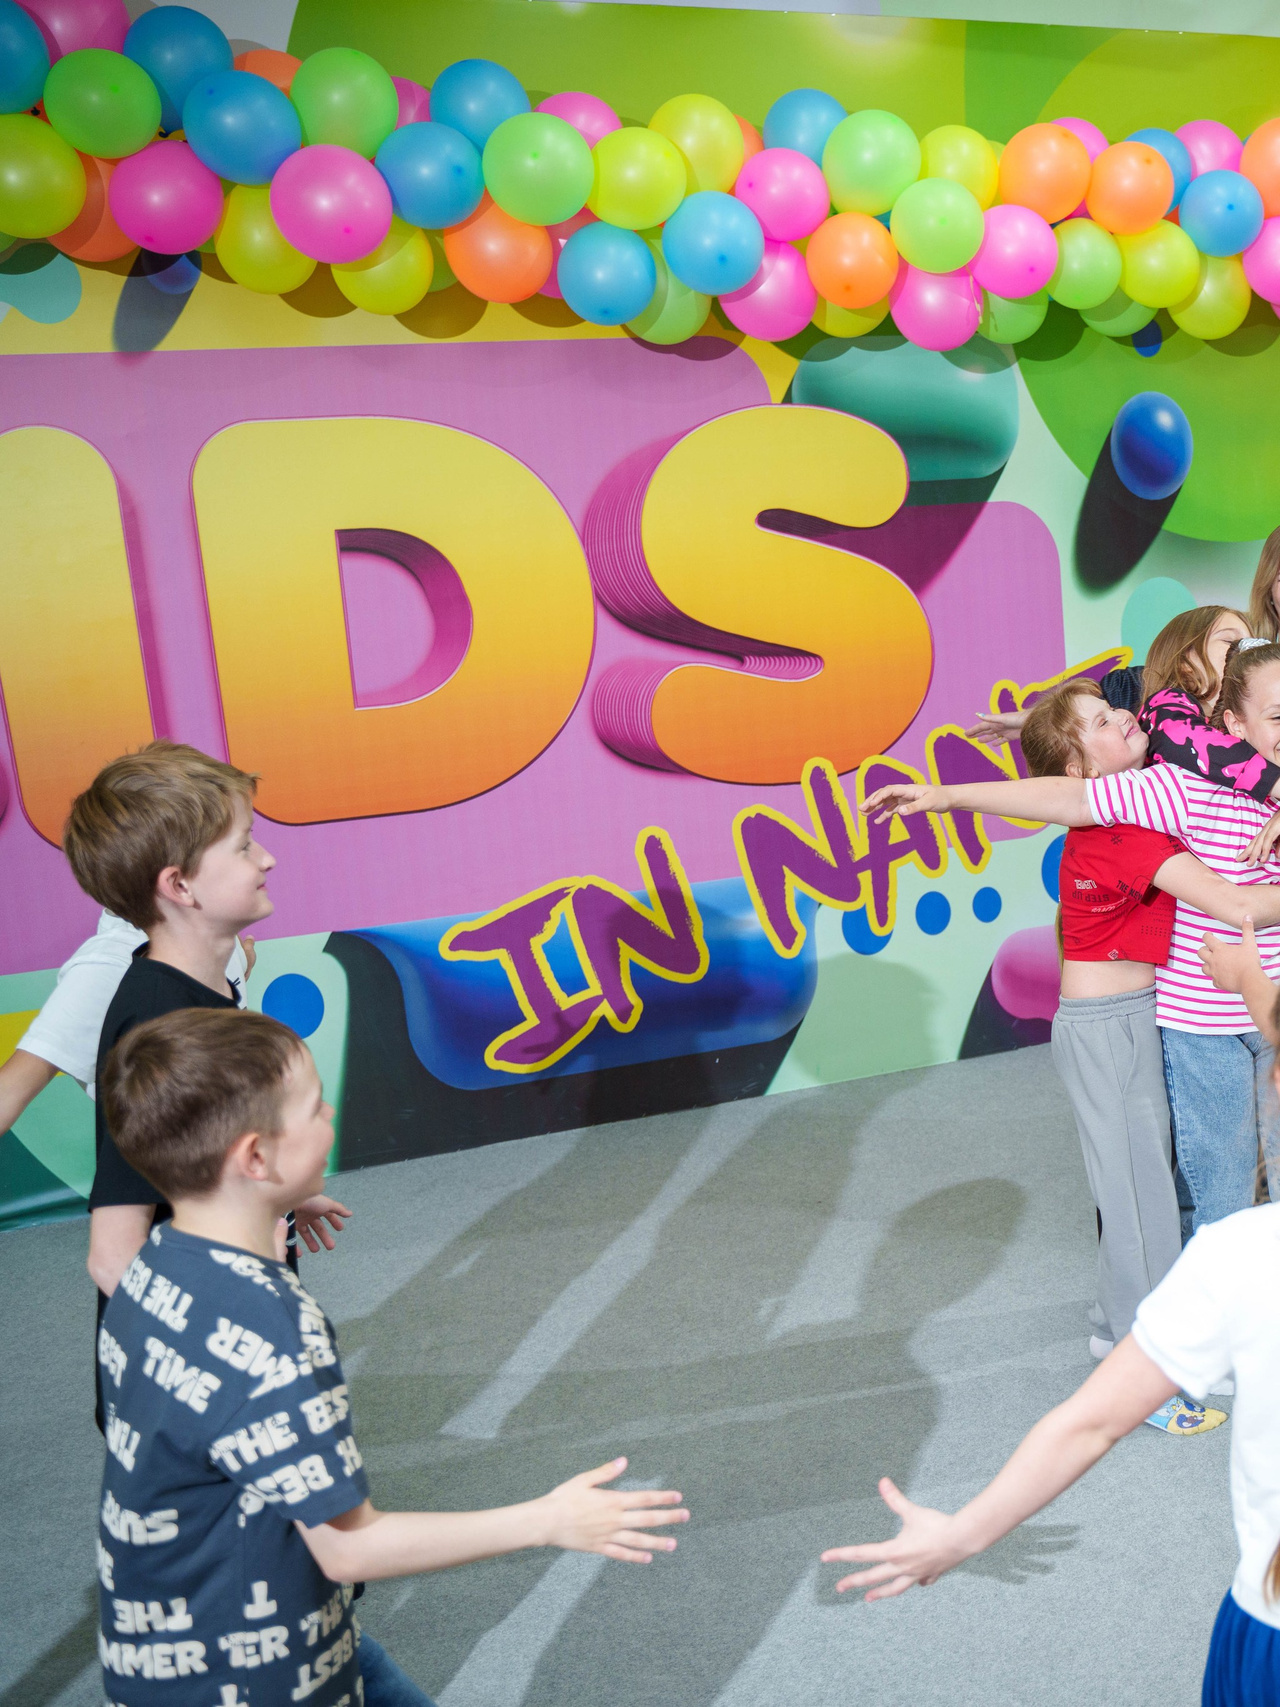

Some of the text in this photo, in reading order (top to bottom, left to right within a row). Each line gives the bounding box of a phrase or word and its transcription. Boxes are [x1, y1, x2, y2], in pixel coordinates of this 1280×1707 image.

[1072, 889, 1110, 903] STEP UP
[440, 826, 708, 1074] IN
[141, 1274, 193, 1333] THE
[209, 1412, 299, 1473] THE
[299, 1384, 348, 1435] BES
[246, 1454, 335, 1505] BES
[113, 1597, 193, 1635] THE
